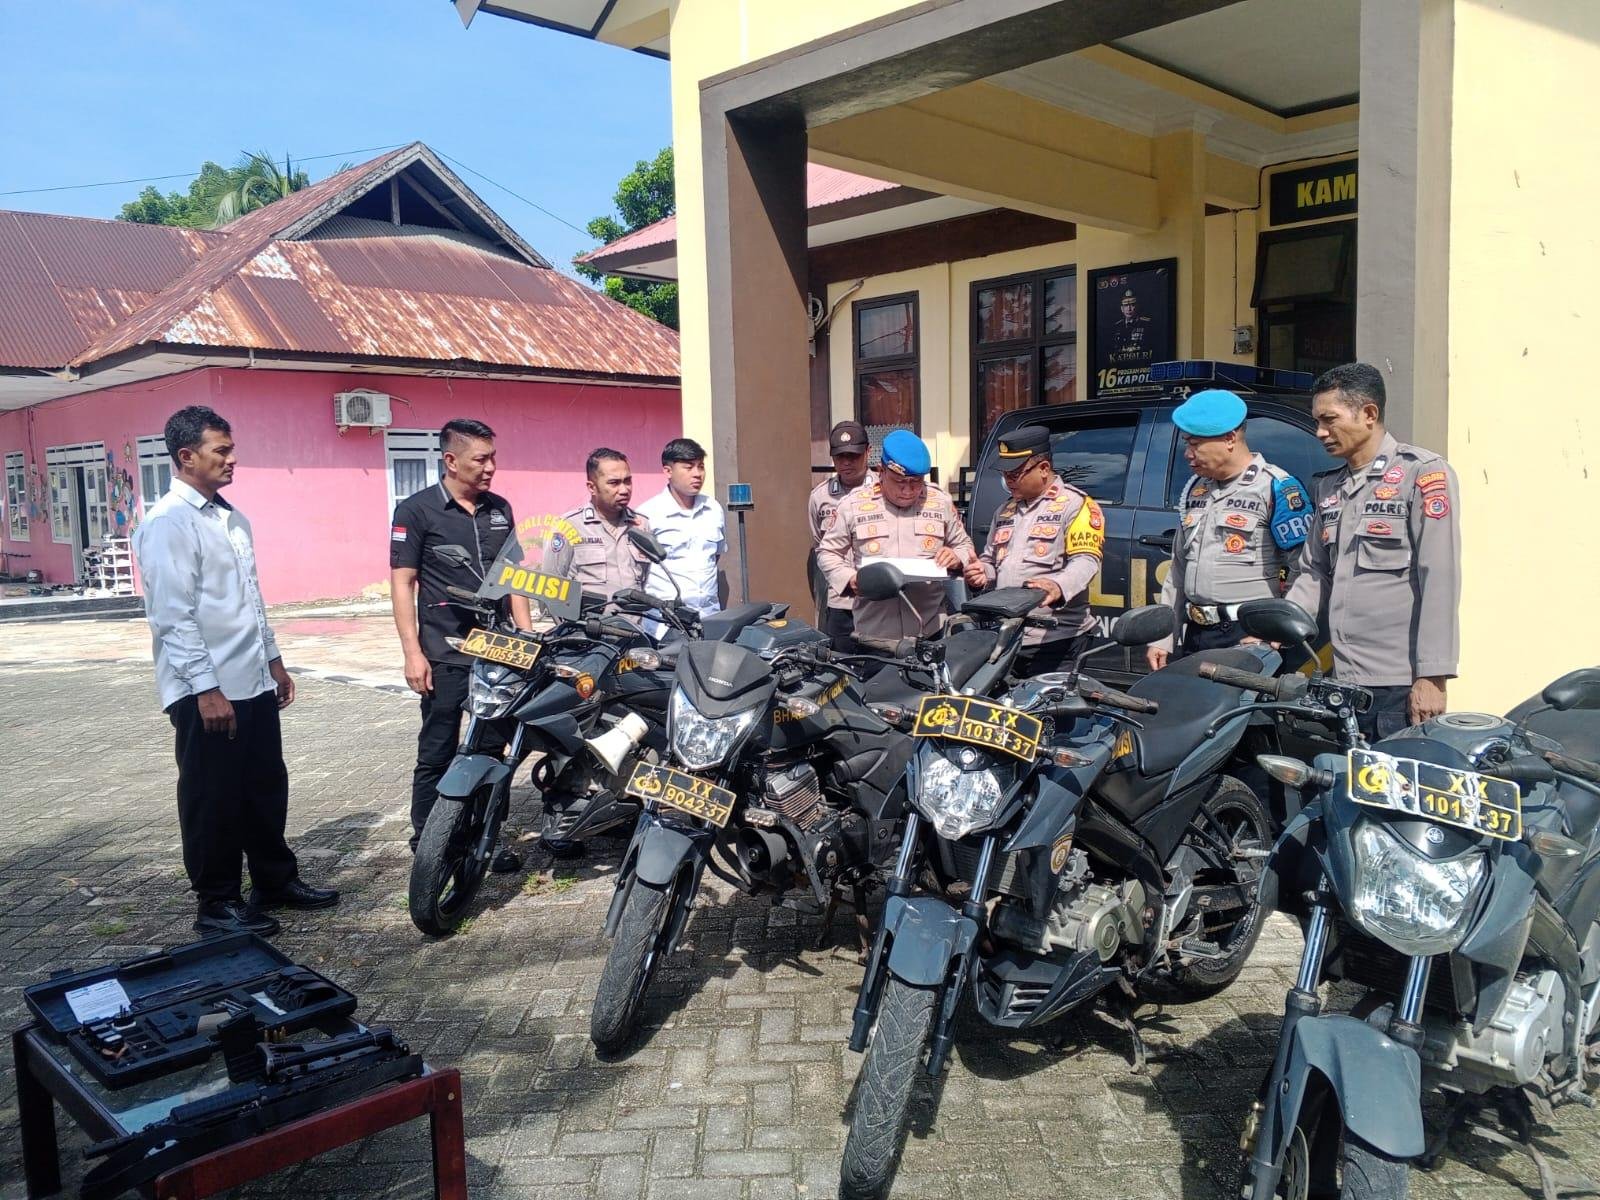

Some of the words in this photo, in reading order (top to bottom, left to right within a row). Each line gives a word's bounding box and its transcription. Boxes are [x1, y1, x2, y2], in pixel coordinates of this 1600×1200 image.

[1098, 368, 1117, 389] 16
[1227, 498, 1260, 511] POLRI
[1365, 503, 1402, 514] POLRI
[916, 511, 943, 520] POLRI
[1037, 514, 1061, 522] POLRI
[498, 566, 570, 601] POLISI
[707, 676, 734, 688] HONDA
[665, 787, 727, 822] 9042-37
